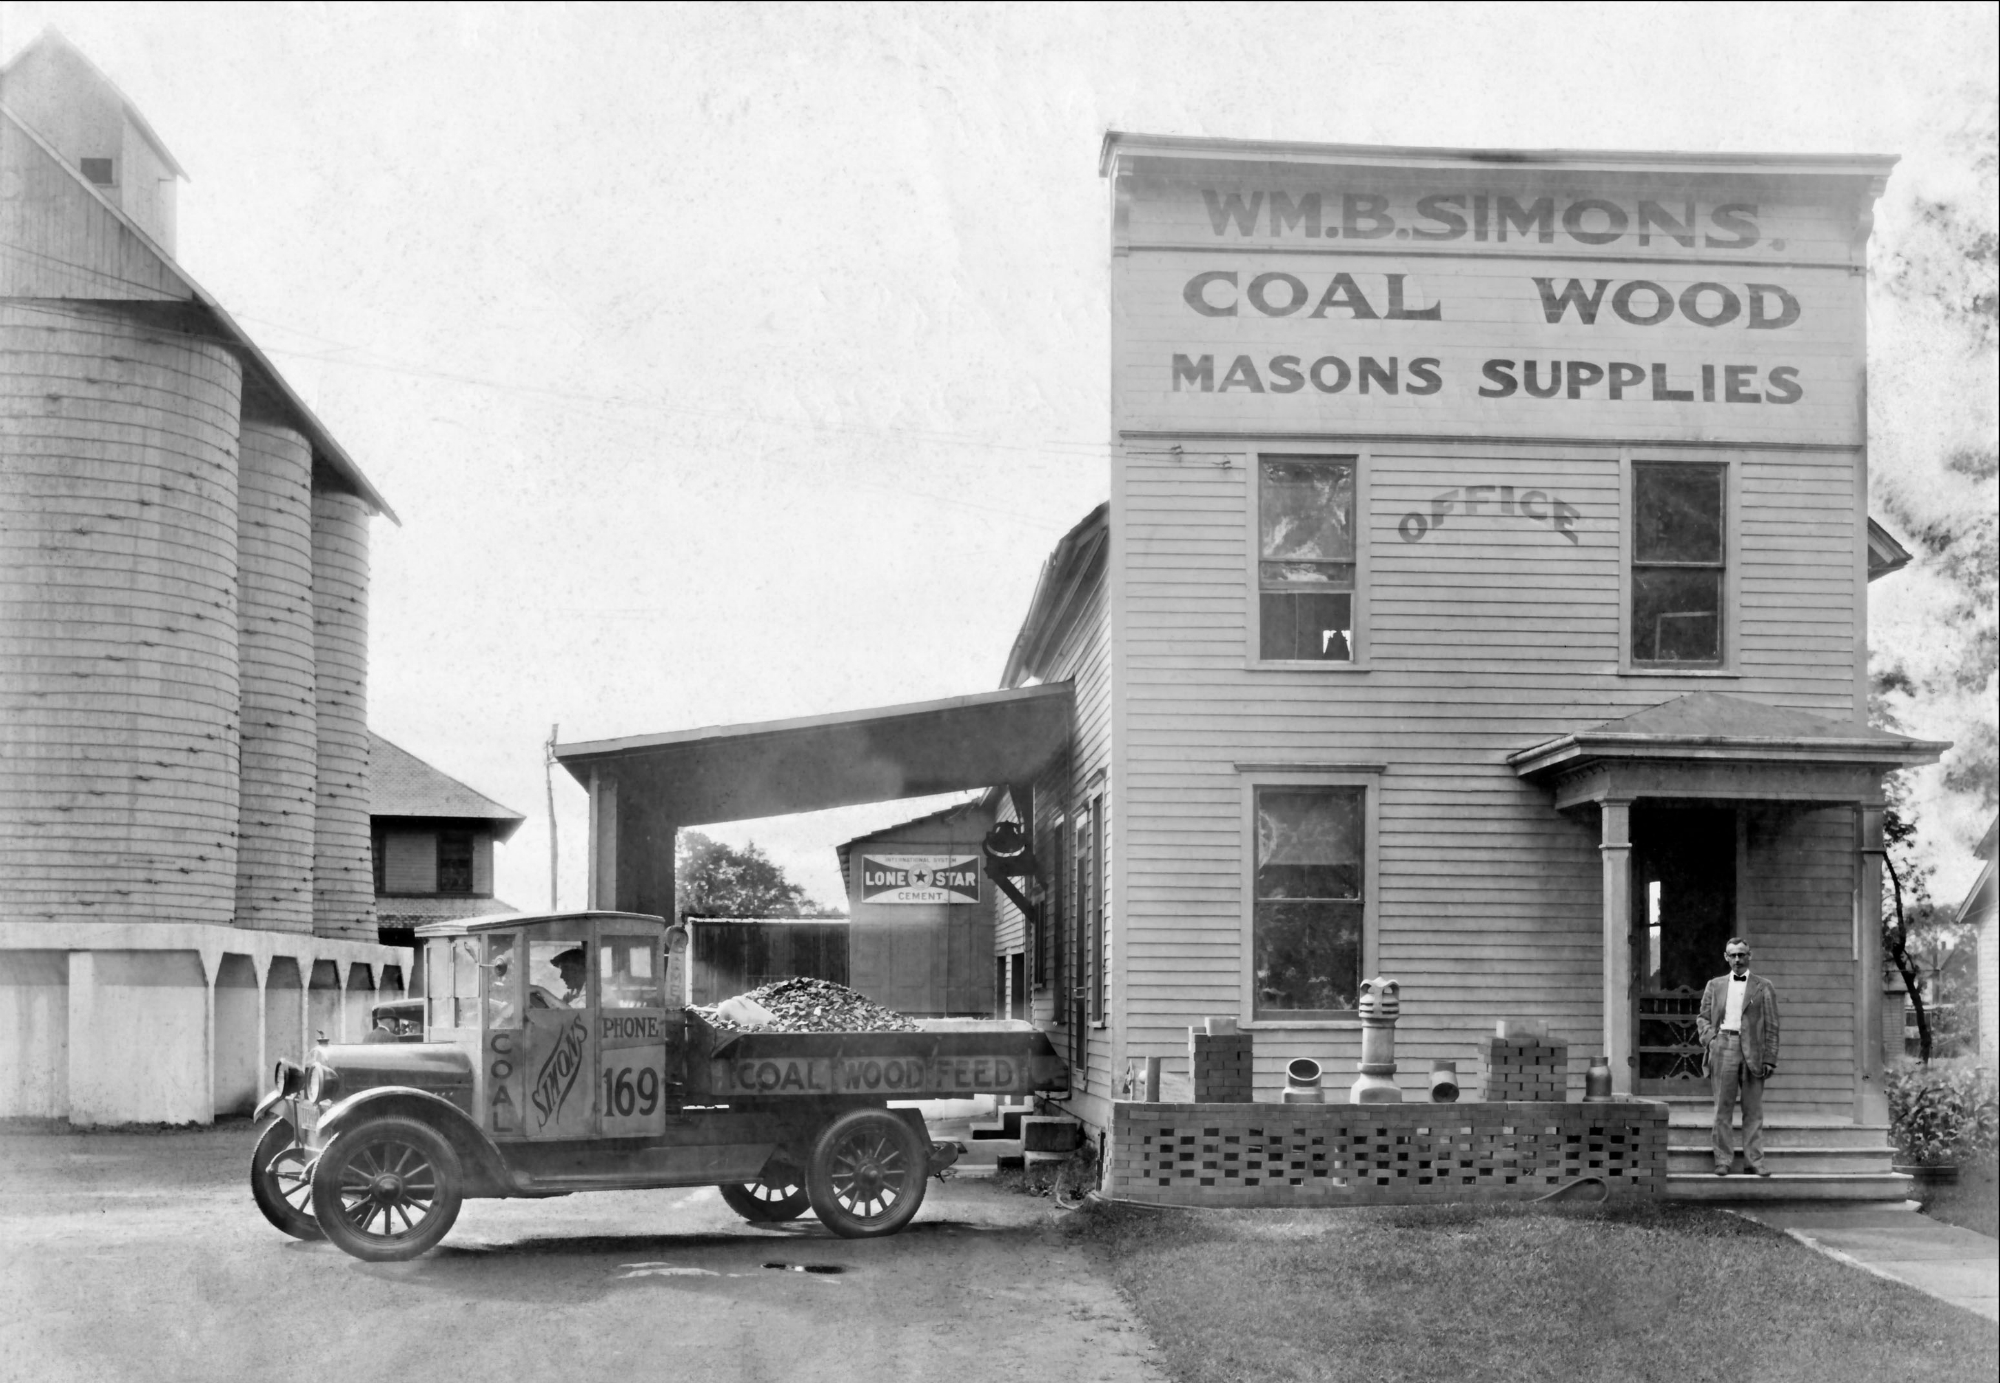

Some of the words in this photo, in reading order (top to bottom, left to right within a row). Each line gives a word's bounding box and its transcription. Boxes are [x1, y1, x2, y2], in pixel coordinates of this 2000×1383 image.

[1182, 271, 1442, 321] COAL
[1531, 277, 1801, 329] WOOD
[1172, 354, 1443, 395] MASONS
[1478, 359, 1803, 404] SUPPLIES
[1398, 485, 1581, 546] OFFICE
[865, 871, 906, 886] LONE
[935, 871, 976, 886] STAR
[898, 892, 943, 900] CEMENT
[602, 1017, 659, 1038] PHONE
[490, 1033, 513, 1132] COAL
[531, 1013, 588, 1132] SIMONS
[603, 1067, 659, 1117] 169
[738, 1061, 825, 1091] COAL
[843, 1060, 925, 1090] WOOD
[935, 1059, 1013, 1089] FEED
